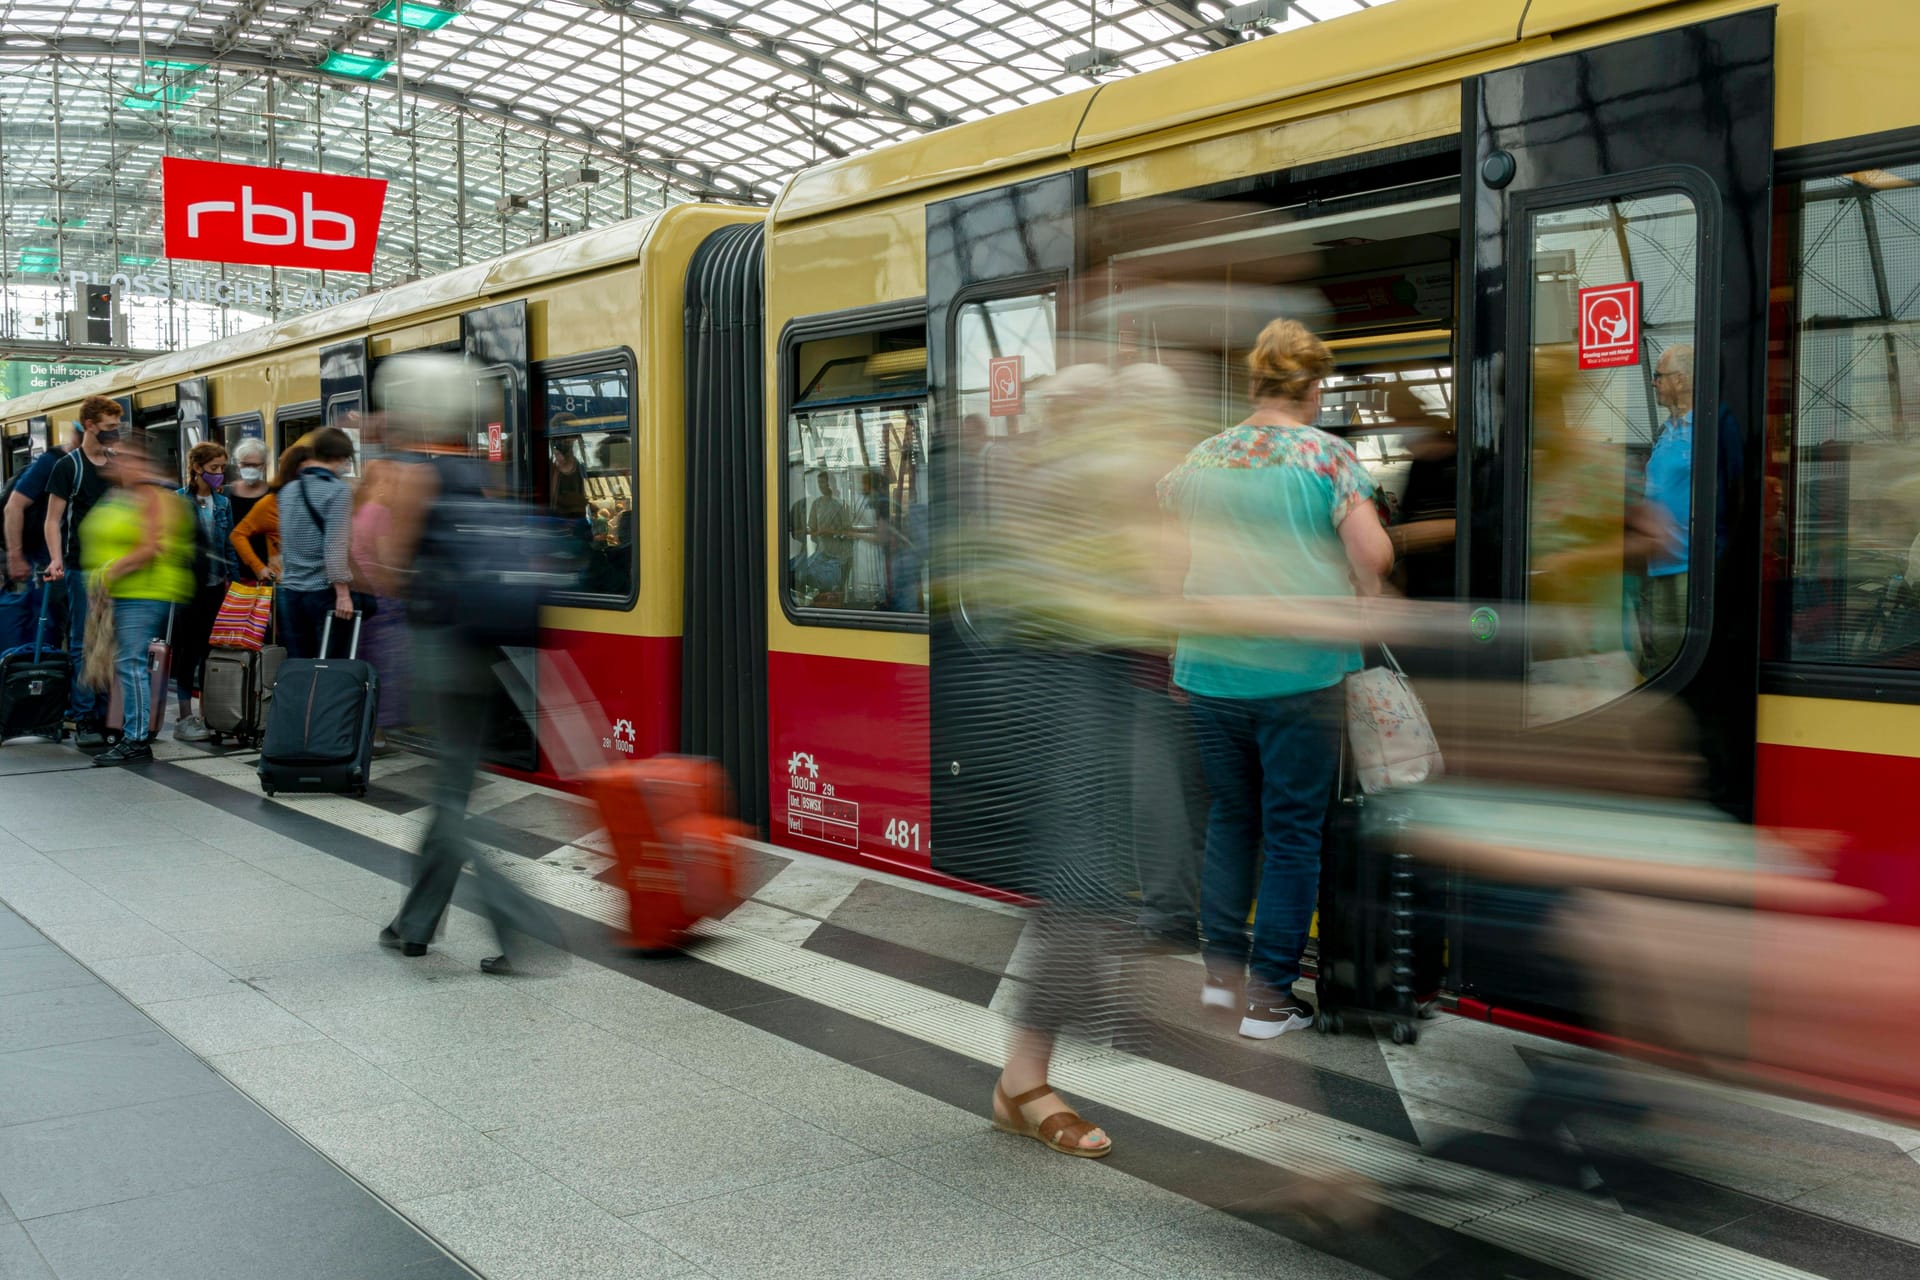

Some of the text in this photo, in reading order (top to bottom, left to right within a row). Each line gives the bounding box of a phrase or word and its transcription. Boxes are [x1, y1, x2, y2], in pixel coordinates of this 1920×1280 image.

[187, 185, 356, 251] rbb
[182, 280, 273, 306] NICHT
[31, 364, 47, 374] Die
[50, 364, 67, 375] hilft
[69, 369, 96, 379] sogar
[31, 376, 47, 387] der
[822, 782, 835, 797] 29t
[885, 818, 920, 851] 481
